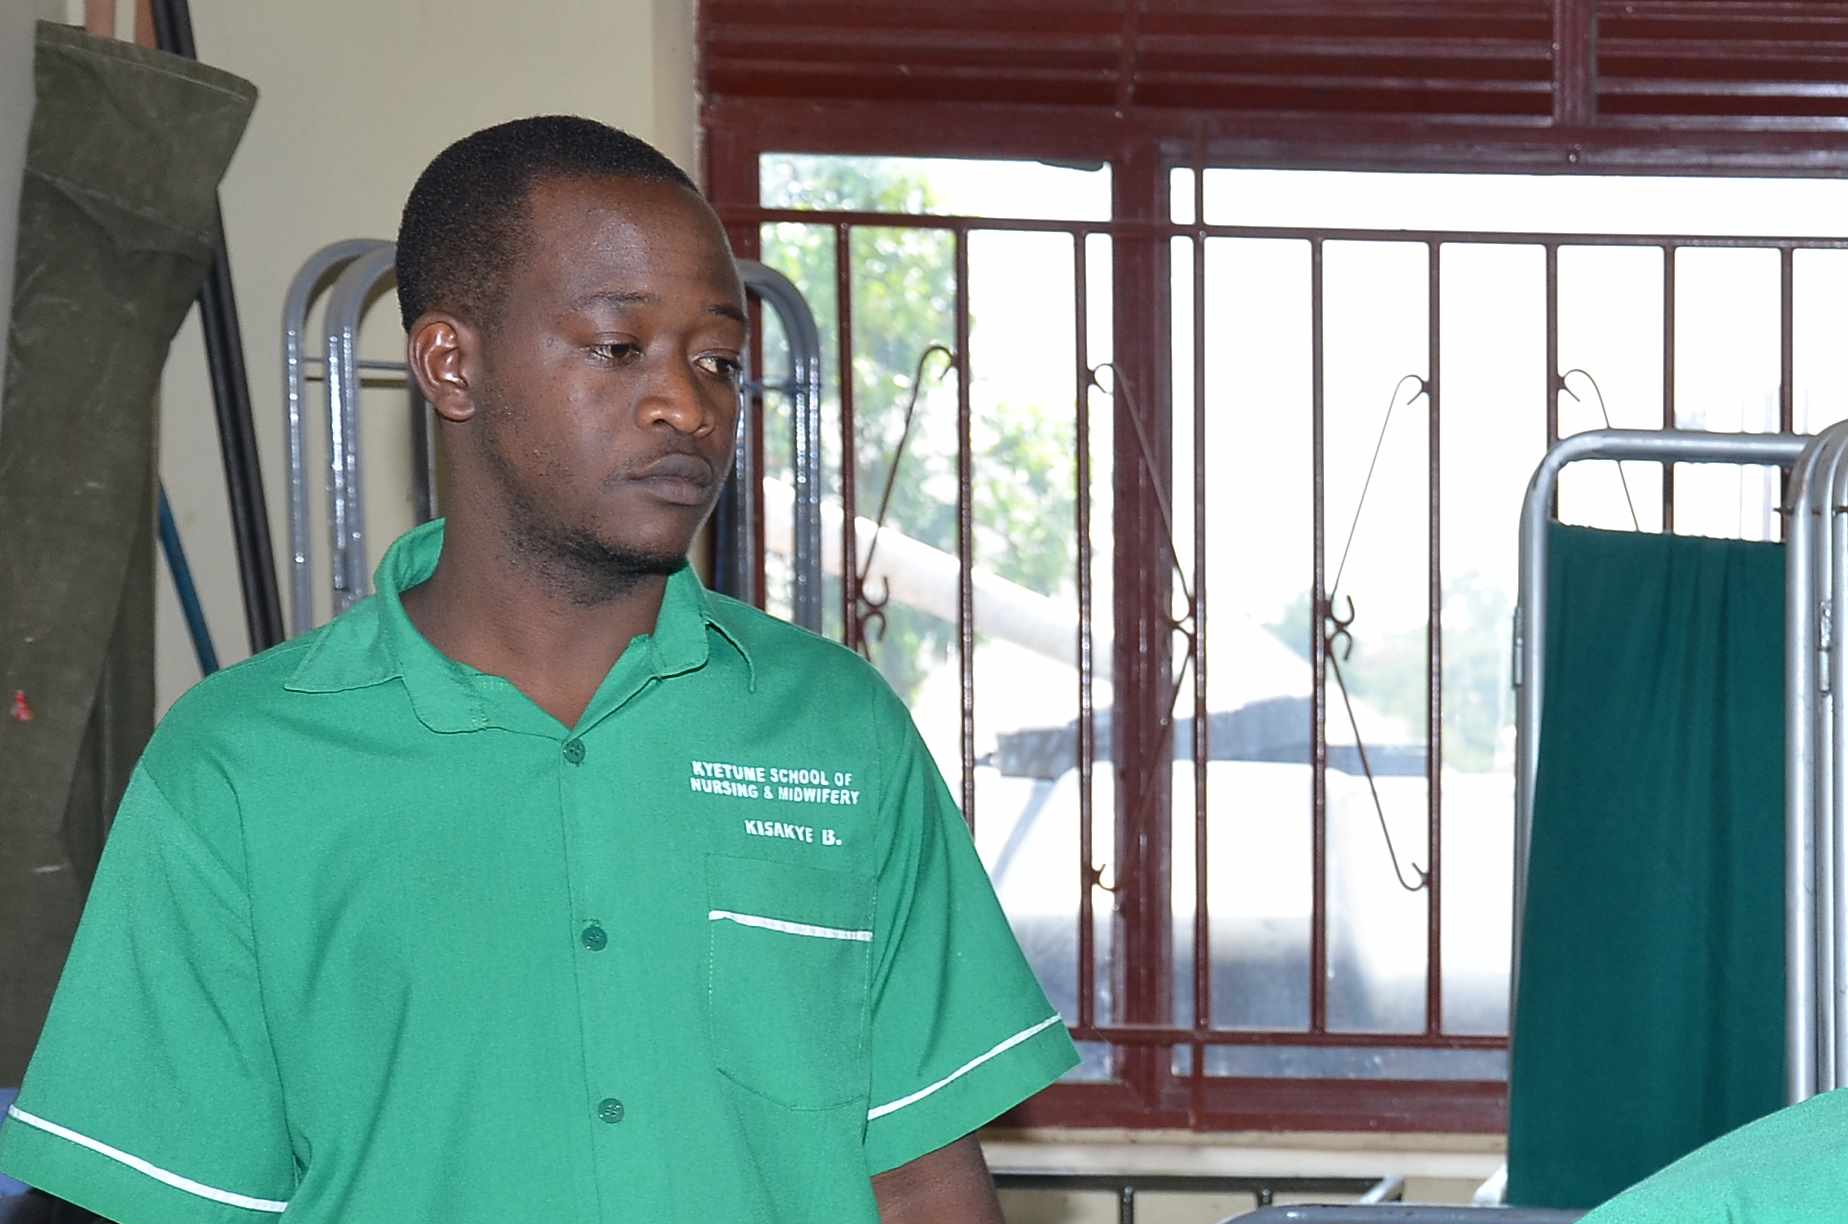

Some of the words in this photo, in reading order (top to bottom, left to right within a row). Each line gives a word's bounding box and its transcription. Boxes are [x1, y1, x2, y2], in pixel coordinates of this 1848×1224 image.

[770, 767, 830, 786] SCHOOL
[834, 772, 853, 787] OF
[689, 777, 759, 799] NURSING
[763, 785, 774, 800] &
[778, 786, 860, 806] MIDWIFERY
[744, 819, 814, 844] KISAKYE
[822, 829, 842, 846] B.
